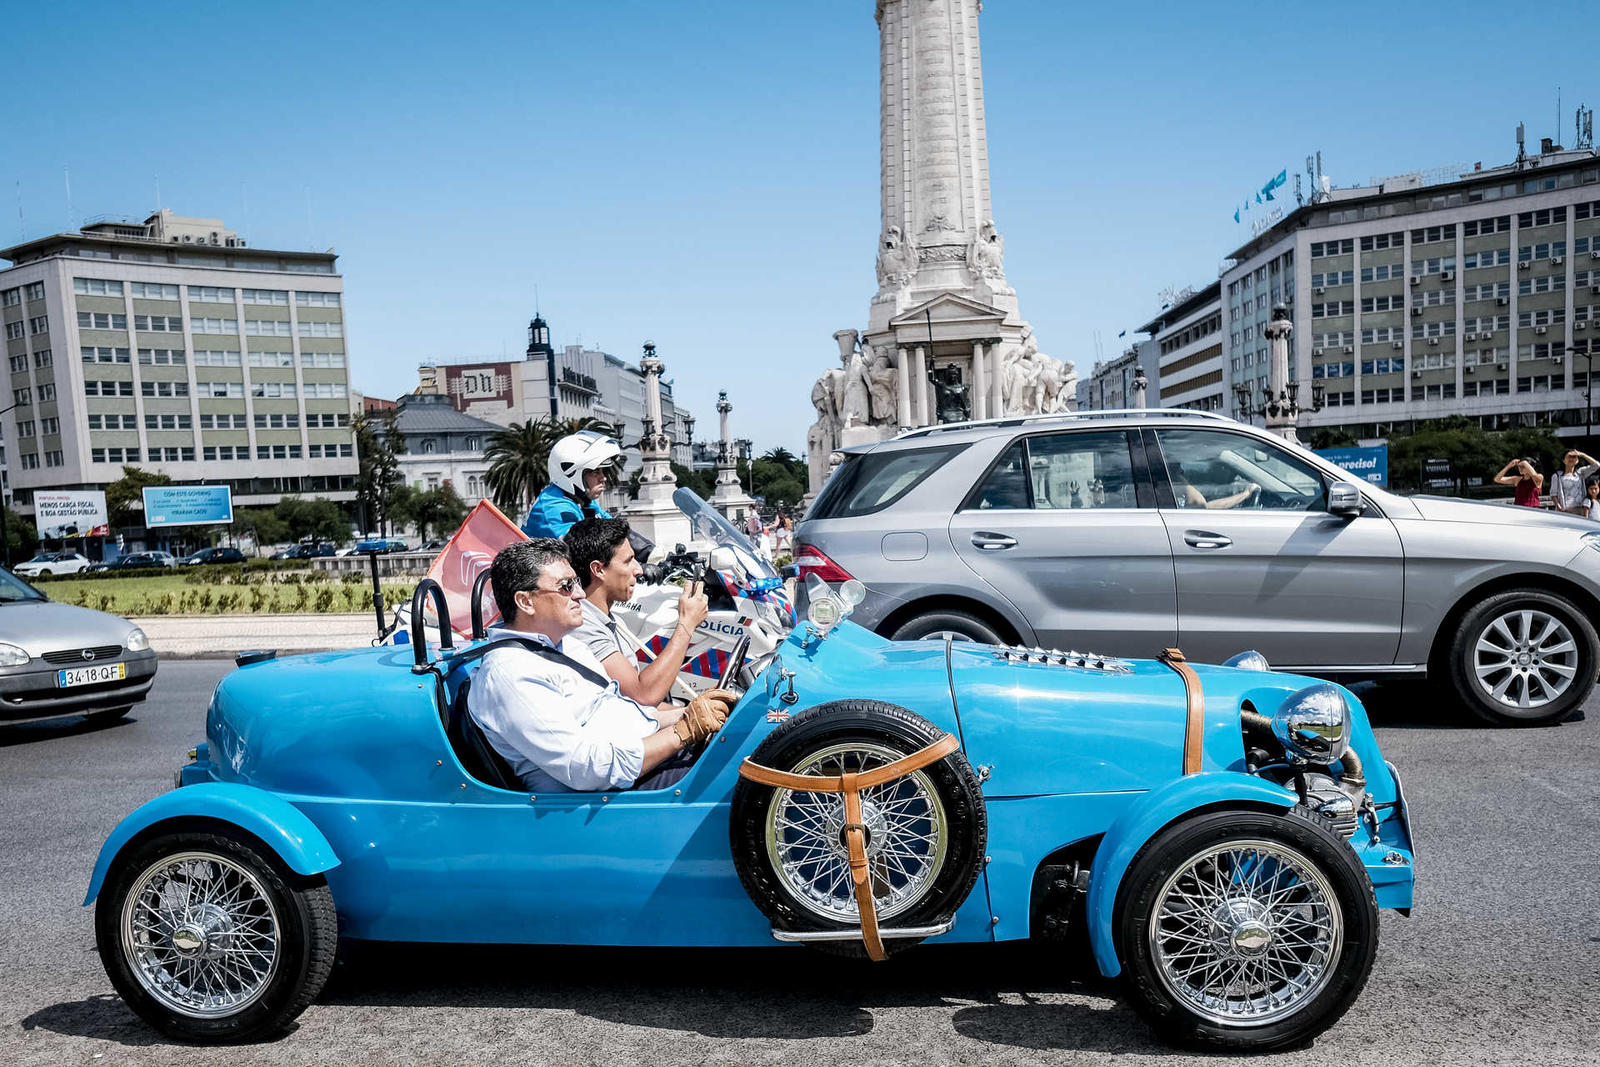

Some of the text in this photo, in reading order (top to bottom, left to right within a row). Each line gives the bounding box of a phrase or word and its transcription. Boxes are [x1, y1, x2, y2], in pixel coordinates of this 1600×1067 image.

[60, 501, 76, 509] CARGA
[614, 601, 642, 612] AMAHA
[697, 620, 744, 636] OLÍCIA
